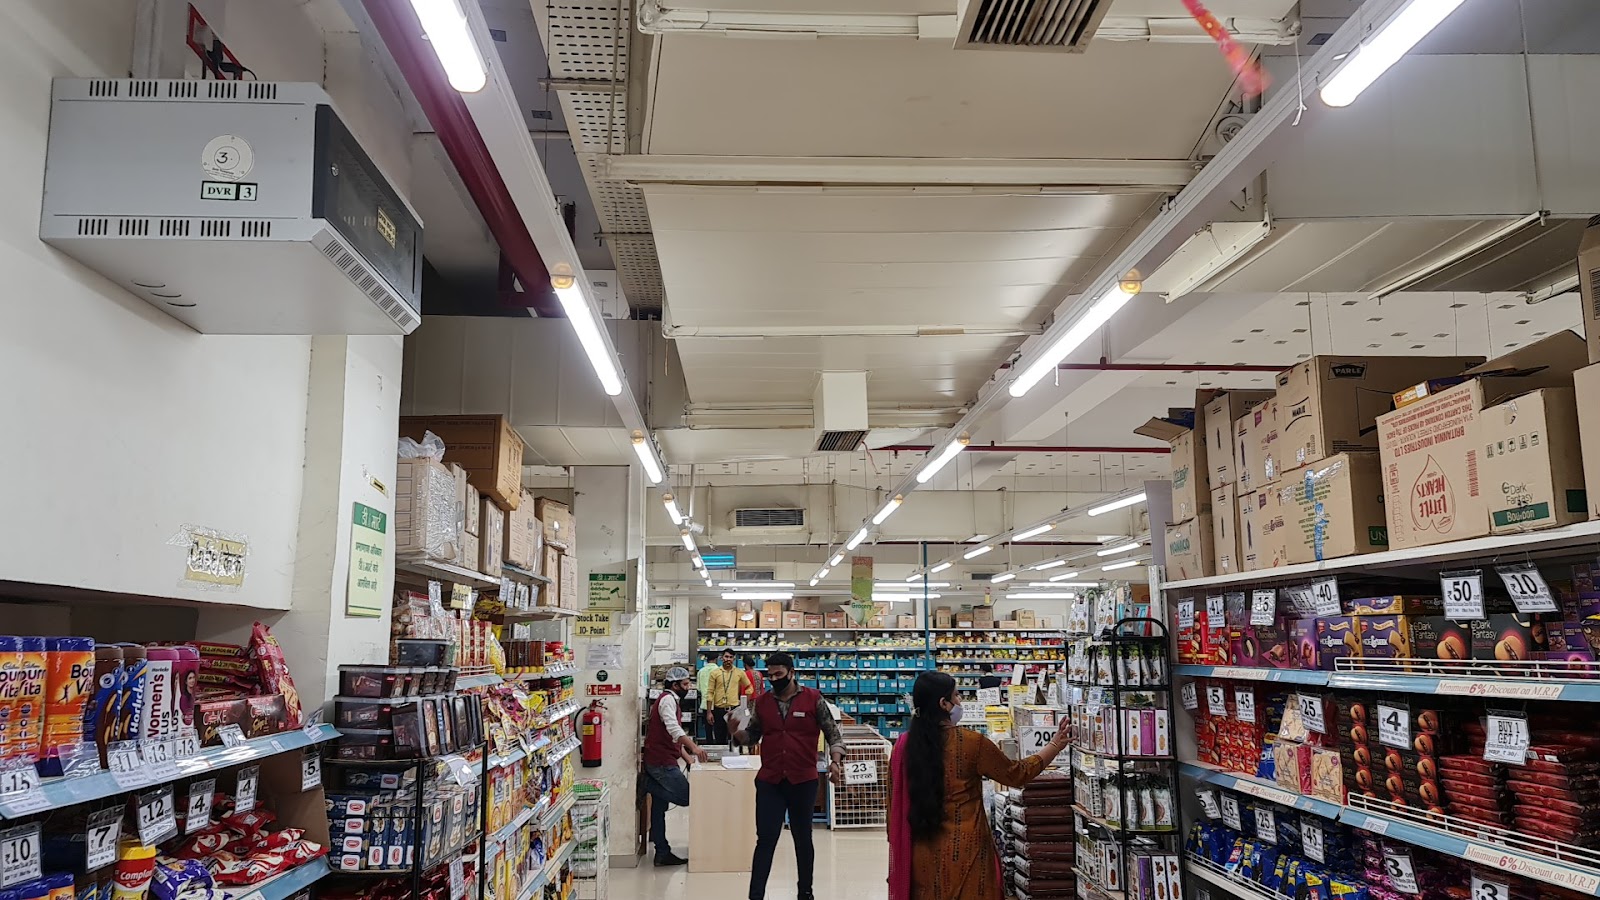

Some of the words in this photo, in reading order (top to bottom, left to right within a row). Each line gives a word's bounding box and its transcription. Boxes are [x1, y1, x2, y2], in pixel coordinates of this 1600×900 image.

[207, 186, 231, 196] DVR
[243, 187, 252, 198] 3
[1334, 367, 1363, 375] PARLE
[1434, 425, 1465, 444] BRITANNIA
[1404, 434, 1434, 454] INDUSTRIES
[1416, 474, 1446, 499] HEARTS
[1510, 483, 1527, 495] Dark
[1505, 493, 1534, 506] Fantasy
[851, 602, 872, 611] Grocery
[594, 614, 610, 622] Take
[656, 616, 670, 628] 02
[589, 626, 606, 634] Point
[1418, 622, 1432, 630] Dark
[1478, 620, 1491, 629] Dark
[1415, 631, 1438, 640] Fantasy
[1472, 630, 1498, 639] Fantasy
[1439, 682, 1470, 692] Minimum
[1469, 683, 1486, 695] 6%
[1486, 684, 1521, 695] Discount
[1521, 687, 1531, 695] on
[1531, 686, 1560, 697] M.R.P.
[130, 676, 145, 734] Horlicks
[203, 709, 227, 726] CAKE
[1497, 720, 1513, 732] BUY
[1515, 722, 1520, 733] 1
[1497, 733, 1513, 744] GET
[1514, 734, 1519, 745] 1
[852, 763, 867, 773] 23
[1466, 846, 1500, 864] Minimum
[1499, 855, 1518, 871] 6%
[1518, 860, 1554, 878] Discount
[1554, 872, 1565, 881] on
[1565, 873, 1596, 890] M.R.P.
